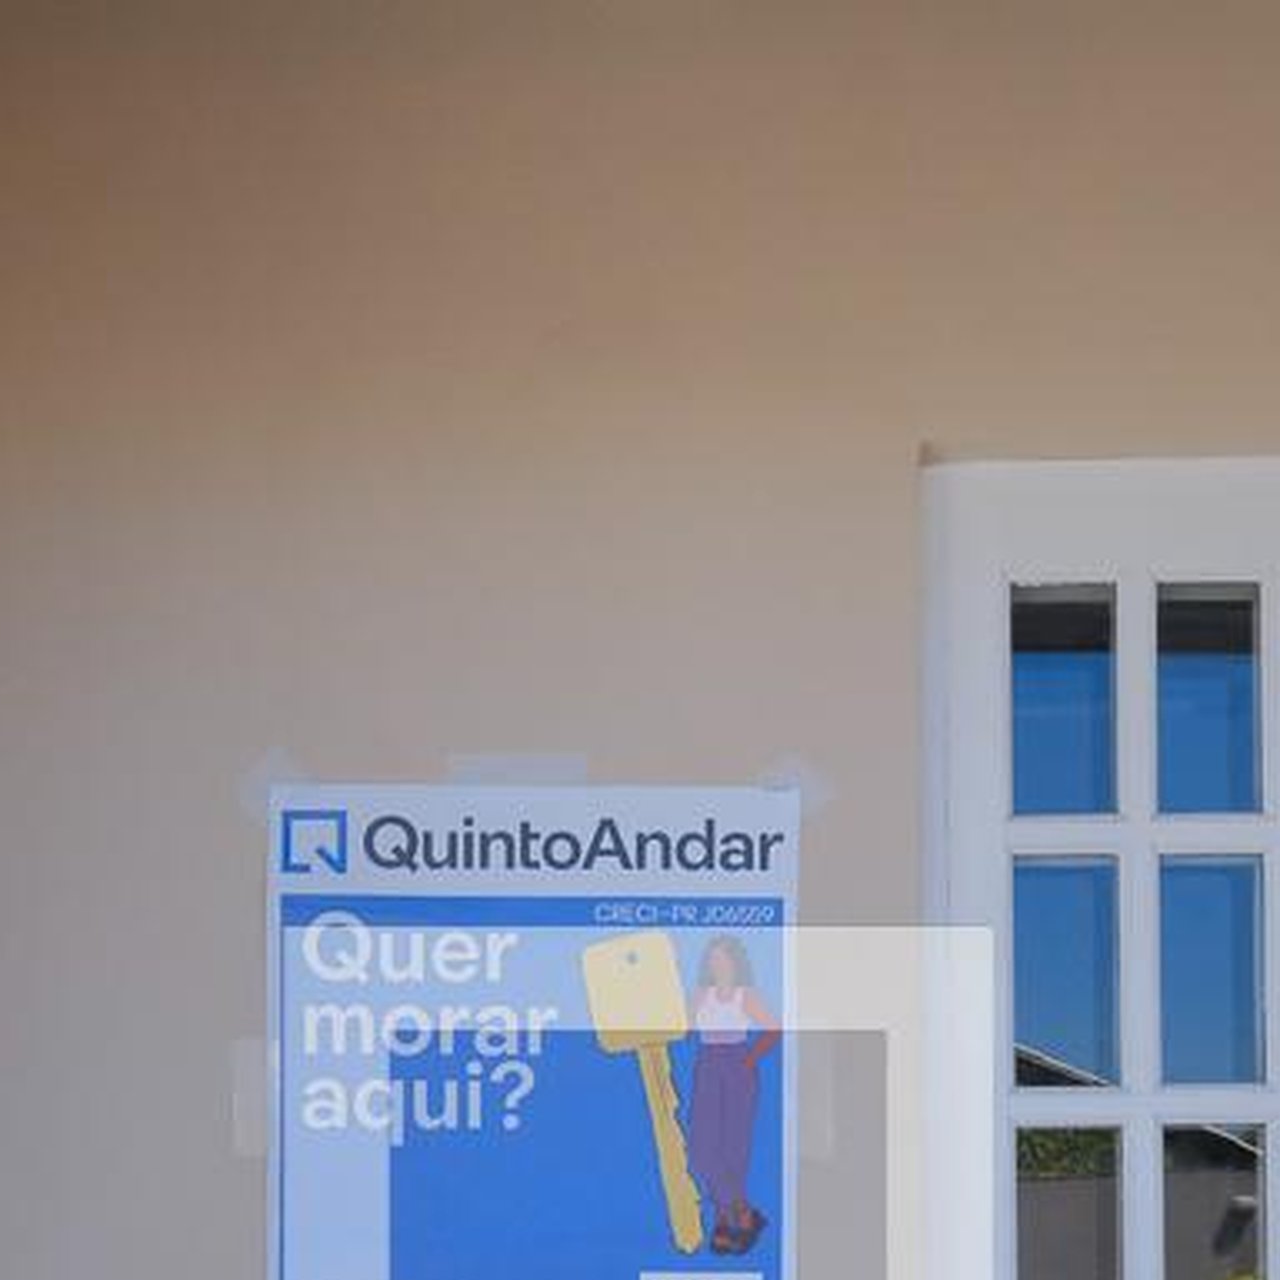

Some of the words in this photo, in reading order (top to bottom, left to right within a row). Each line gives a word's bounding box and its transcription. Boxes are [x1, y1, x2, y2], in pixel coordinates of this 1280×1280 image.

[363, 815, 785, 873] QuintoAndar
[302, 910, 518, 983] Quer
[302, 1003, 558, 1058] morar
[301, 1060, 535, 1147] aqui?
